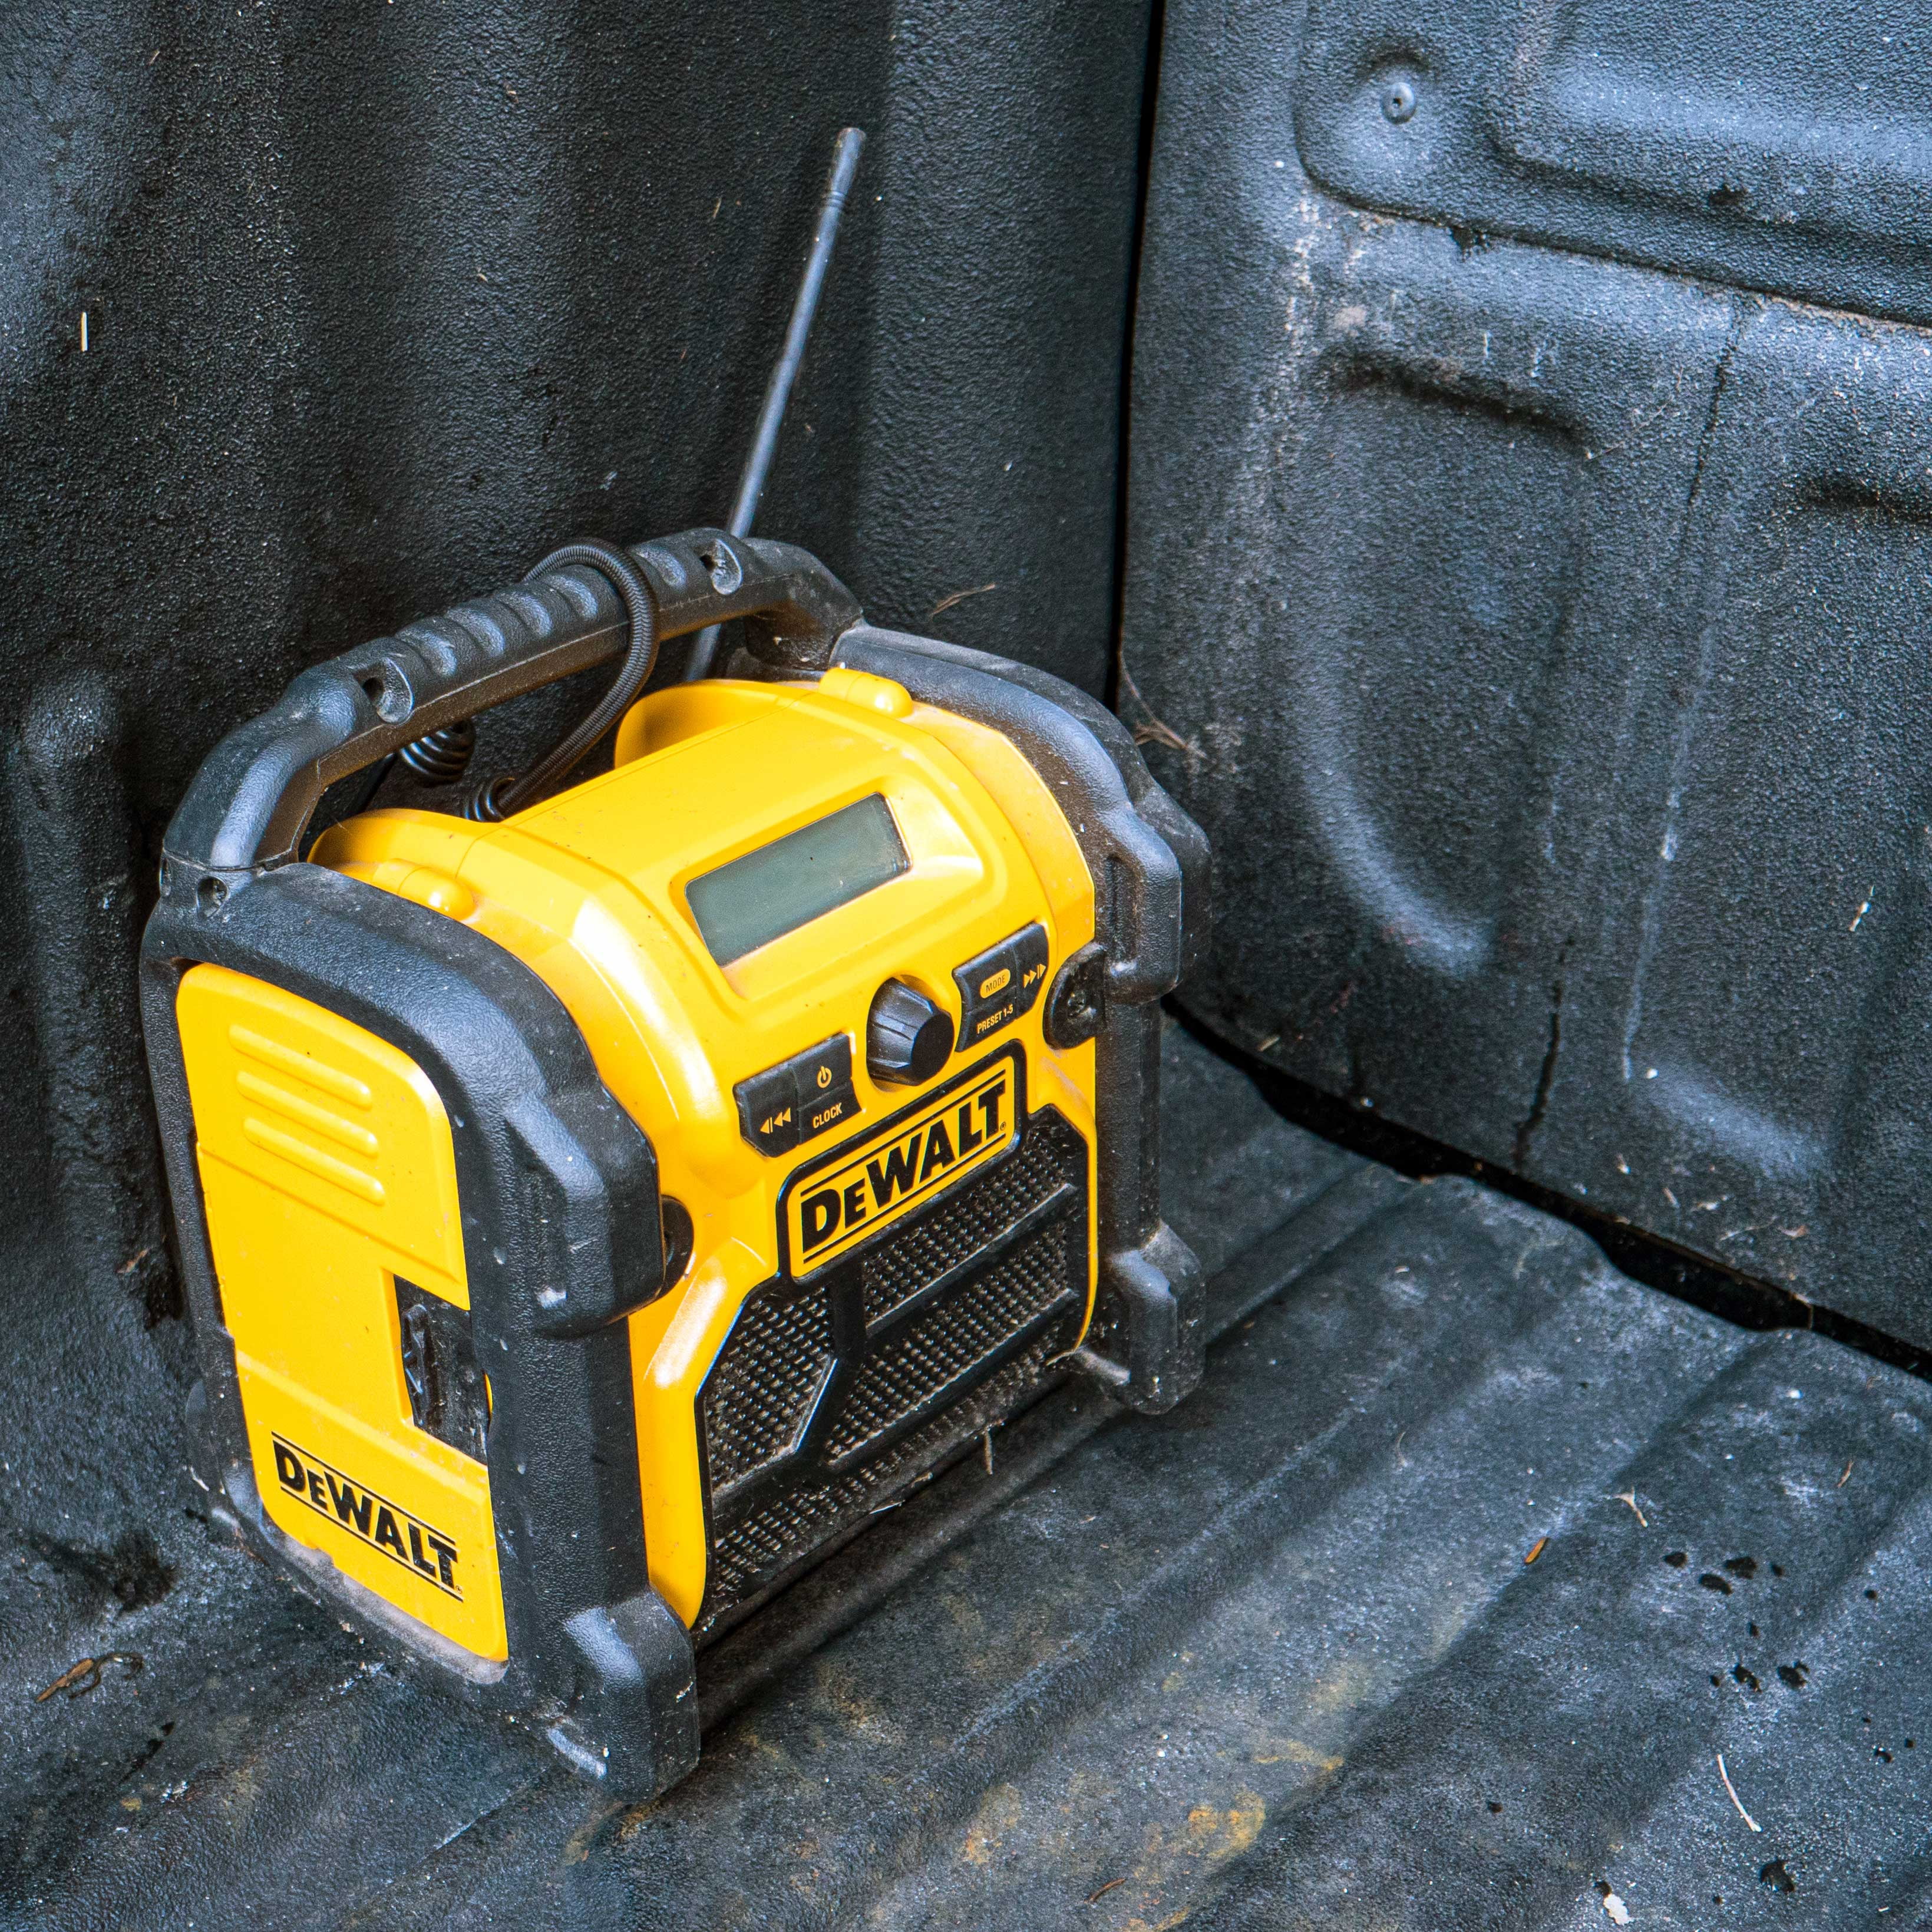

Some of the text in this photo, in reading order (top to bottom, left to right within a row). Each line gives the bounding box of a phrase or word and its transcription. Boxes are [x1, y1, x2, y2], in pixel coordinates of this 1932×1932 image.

[986, 975, 1006, 993] MODE
[977, 1003, 1013, 1034] PRESET 1-5
[813, 1102, 843, 1128] CLOCK
